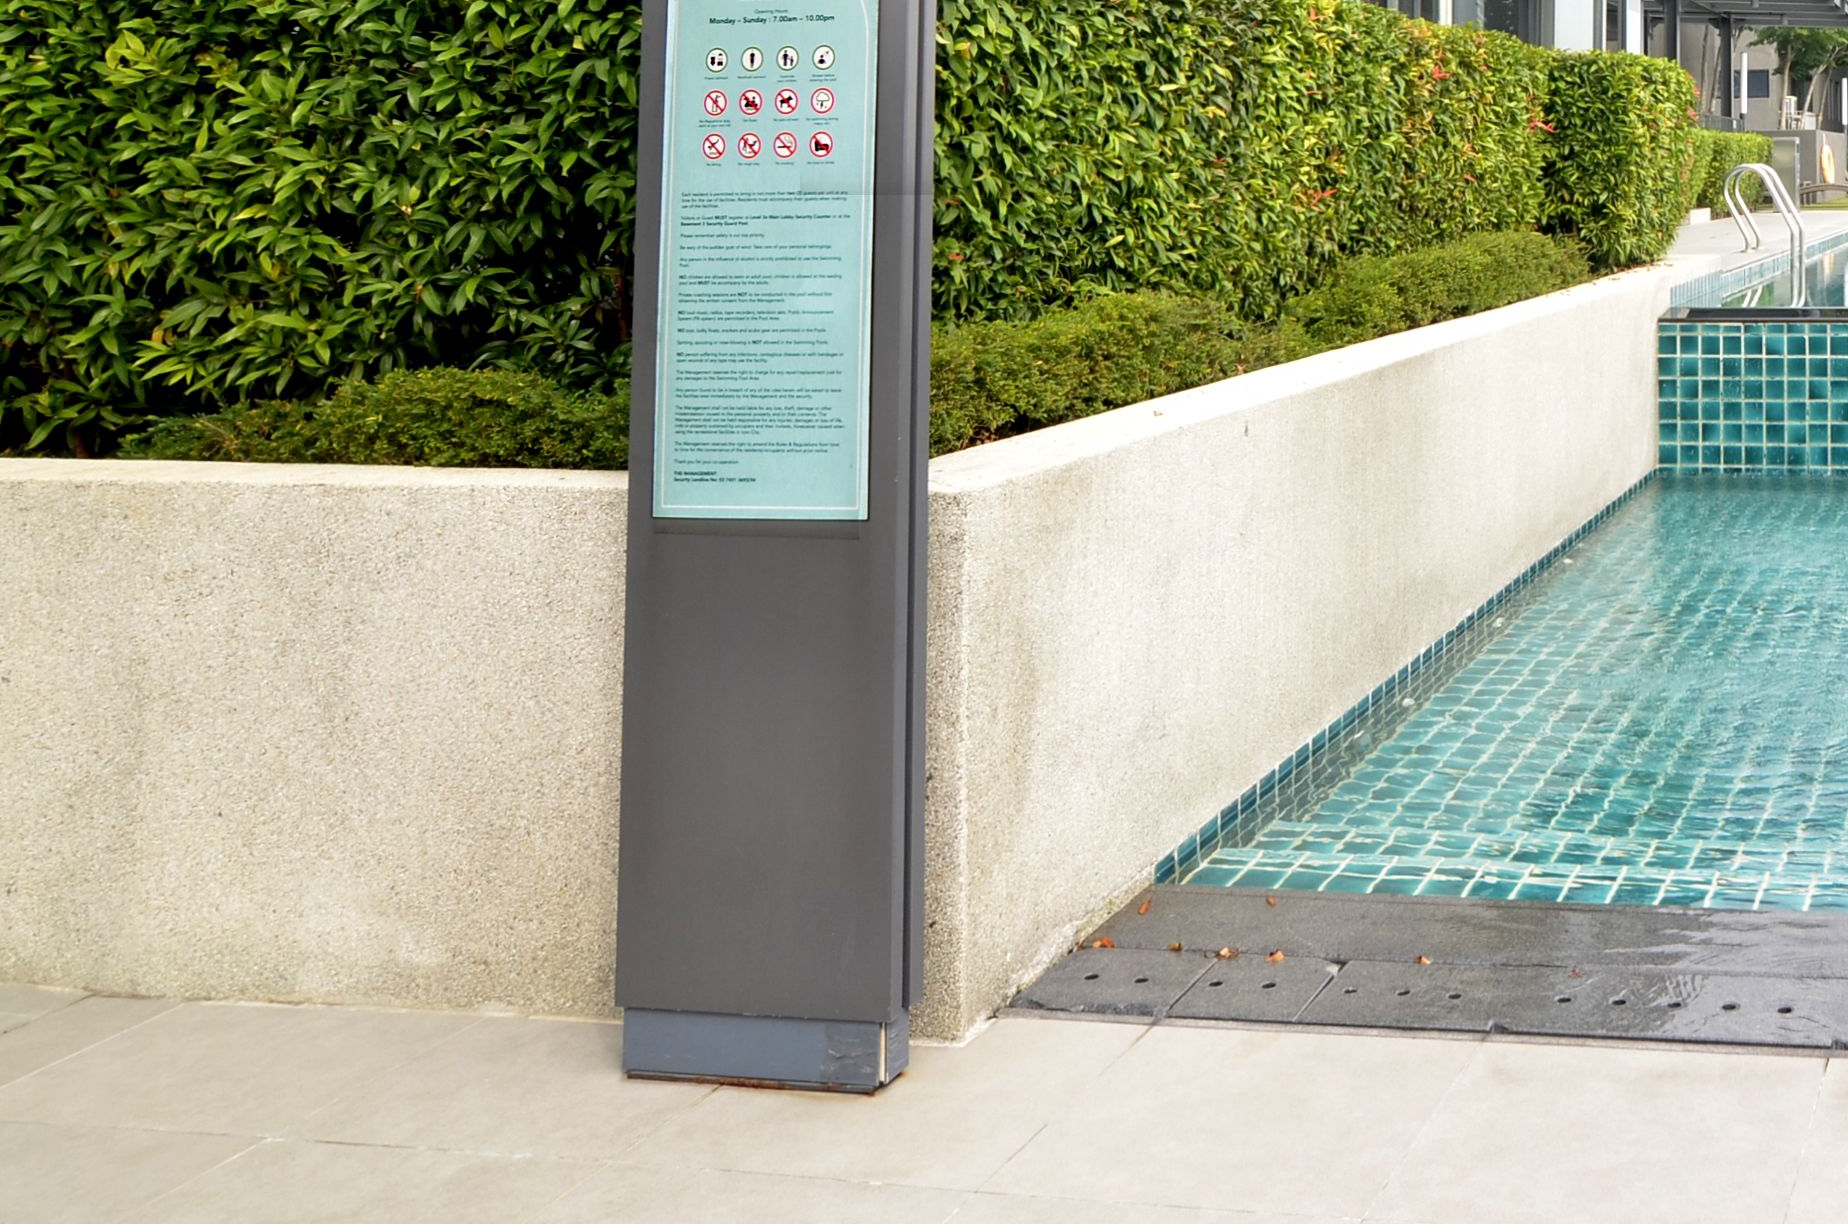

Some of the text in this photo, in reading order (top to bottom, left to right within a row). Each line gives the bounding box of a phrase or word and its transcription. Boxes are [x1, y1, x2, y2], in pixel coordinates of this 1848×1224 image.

[709, 17, 736, 26] Monday
[743, 16, 767, 25] Sunday
[773, 15, 798, 23] 7.00am
[805, 14, 835, 23] 10.00pm
